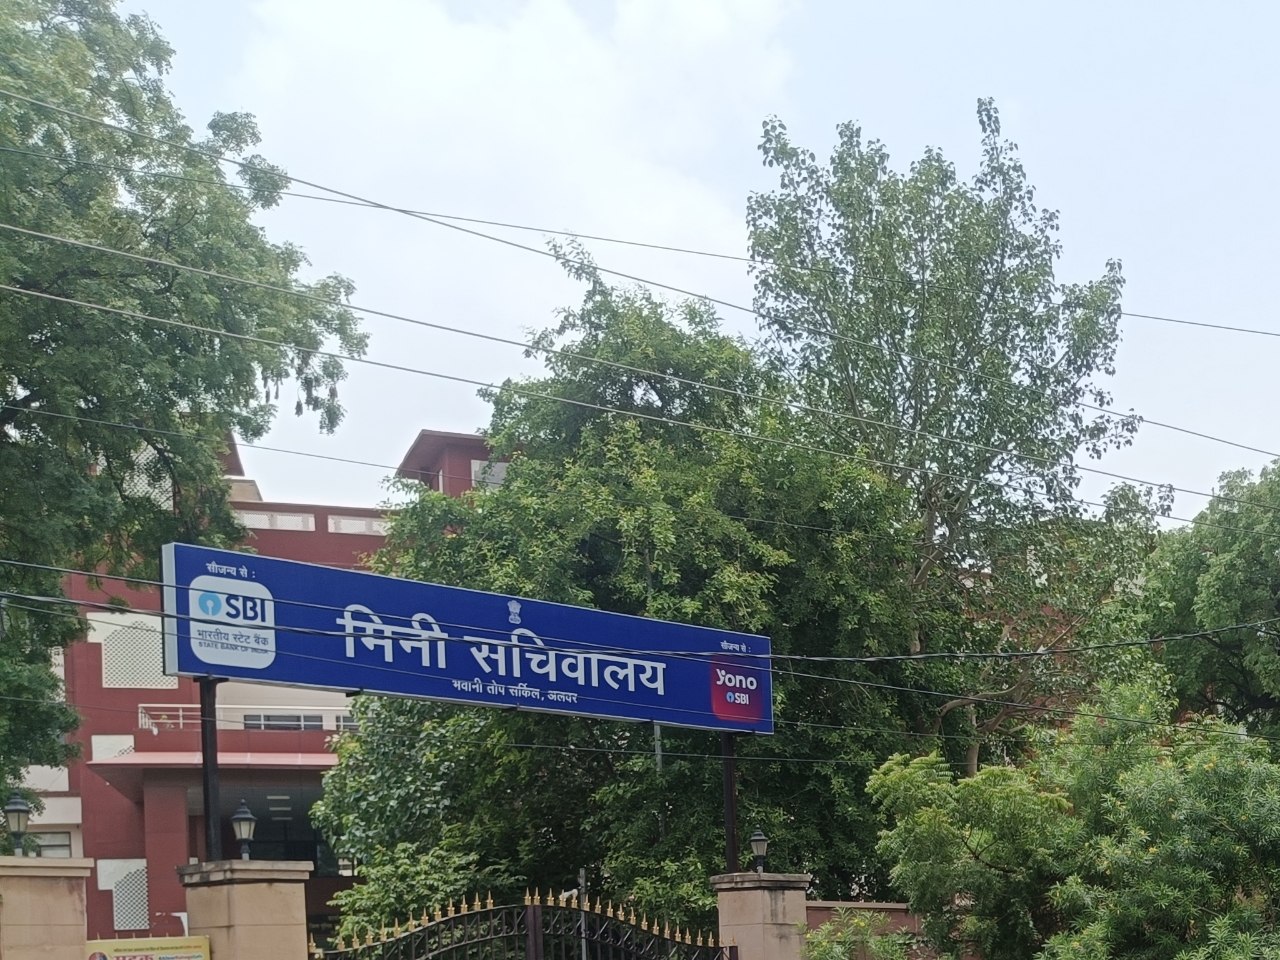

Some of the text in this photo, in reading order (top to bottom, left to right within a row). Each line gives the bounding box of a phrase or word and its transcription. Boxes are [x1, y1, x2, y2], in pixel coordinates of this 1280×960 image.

[205, 560, 237, 576] सौजन्य
[239, 564, 248, 578] से
[225, 594, 266, 622] SBI
[197, 627, 269, 646] भारतीय स्टेट बैंक
[198, 641, 219, 649] STATE
[336, 604, 666, 695] मिनी सचिवालय
[452, 677, 483, 693] भवानी
[486, 680, 505, 695] तोप
[734, 692, 749, 705] SBI
